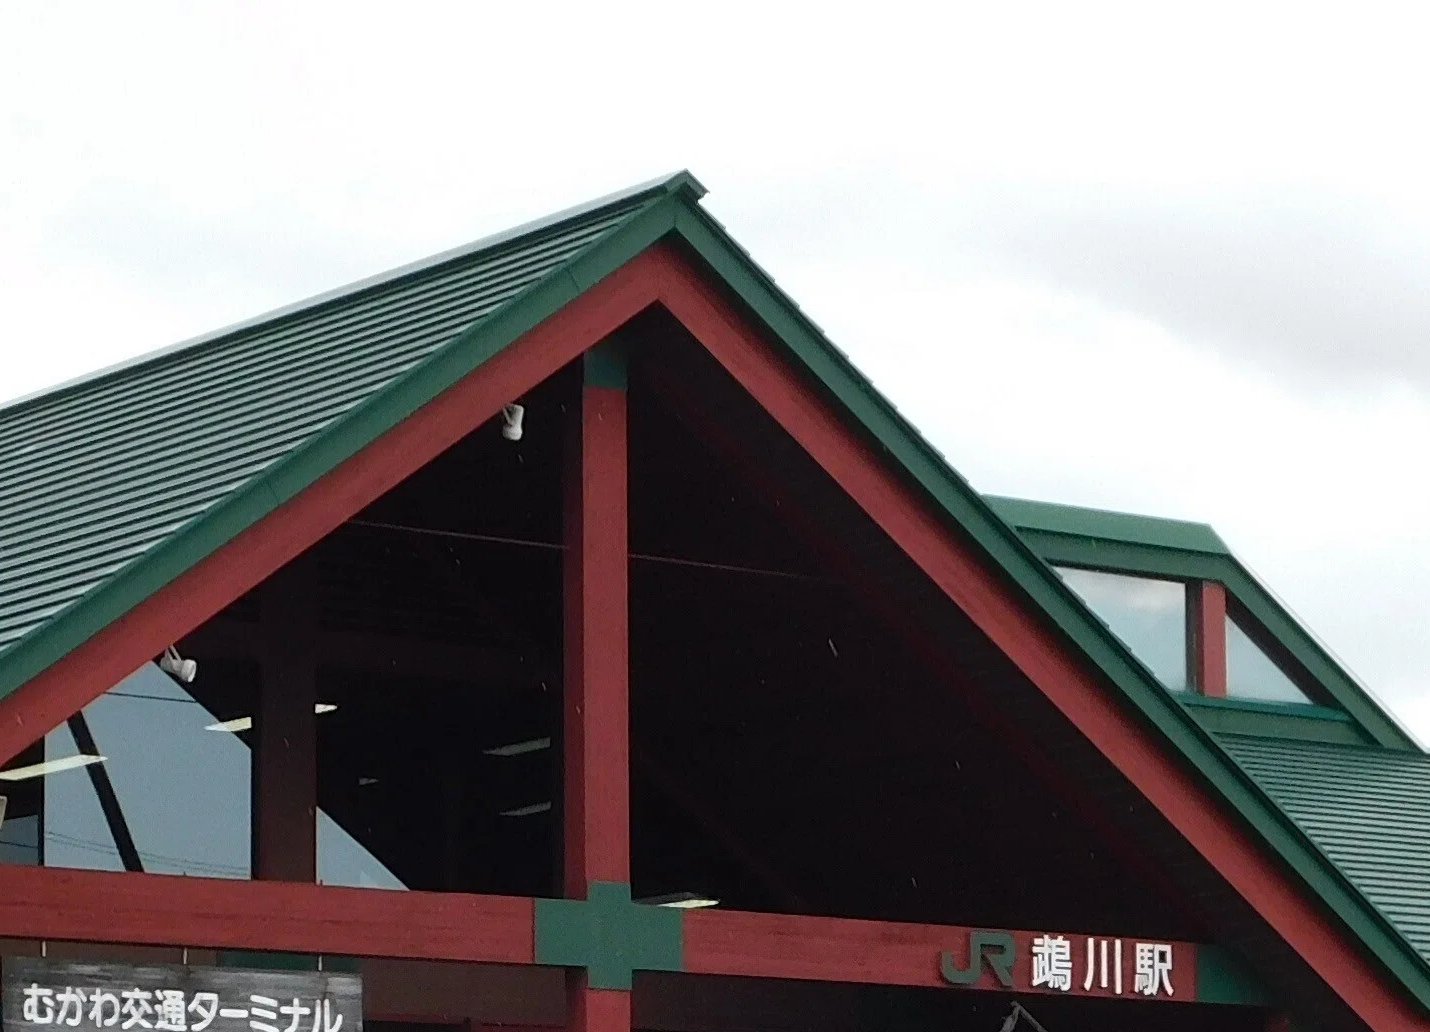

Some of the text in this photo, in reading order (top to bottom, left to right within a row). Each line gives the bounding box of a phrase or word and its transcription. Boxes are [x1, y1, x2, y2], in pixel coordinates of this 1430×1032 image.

[940, 930, 1175, 997] JR 鵡川駅
